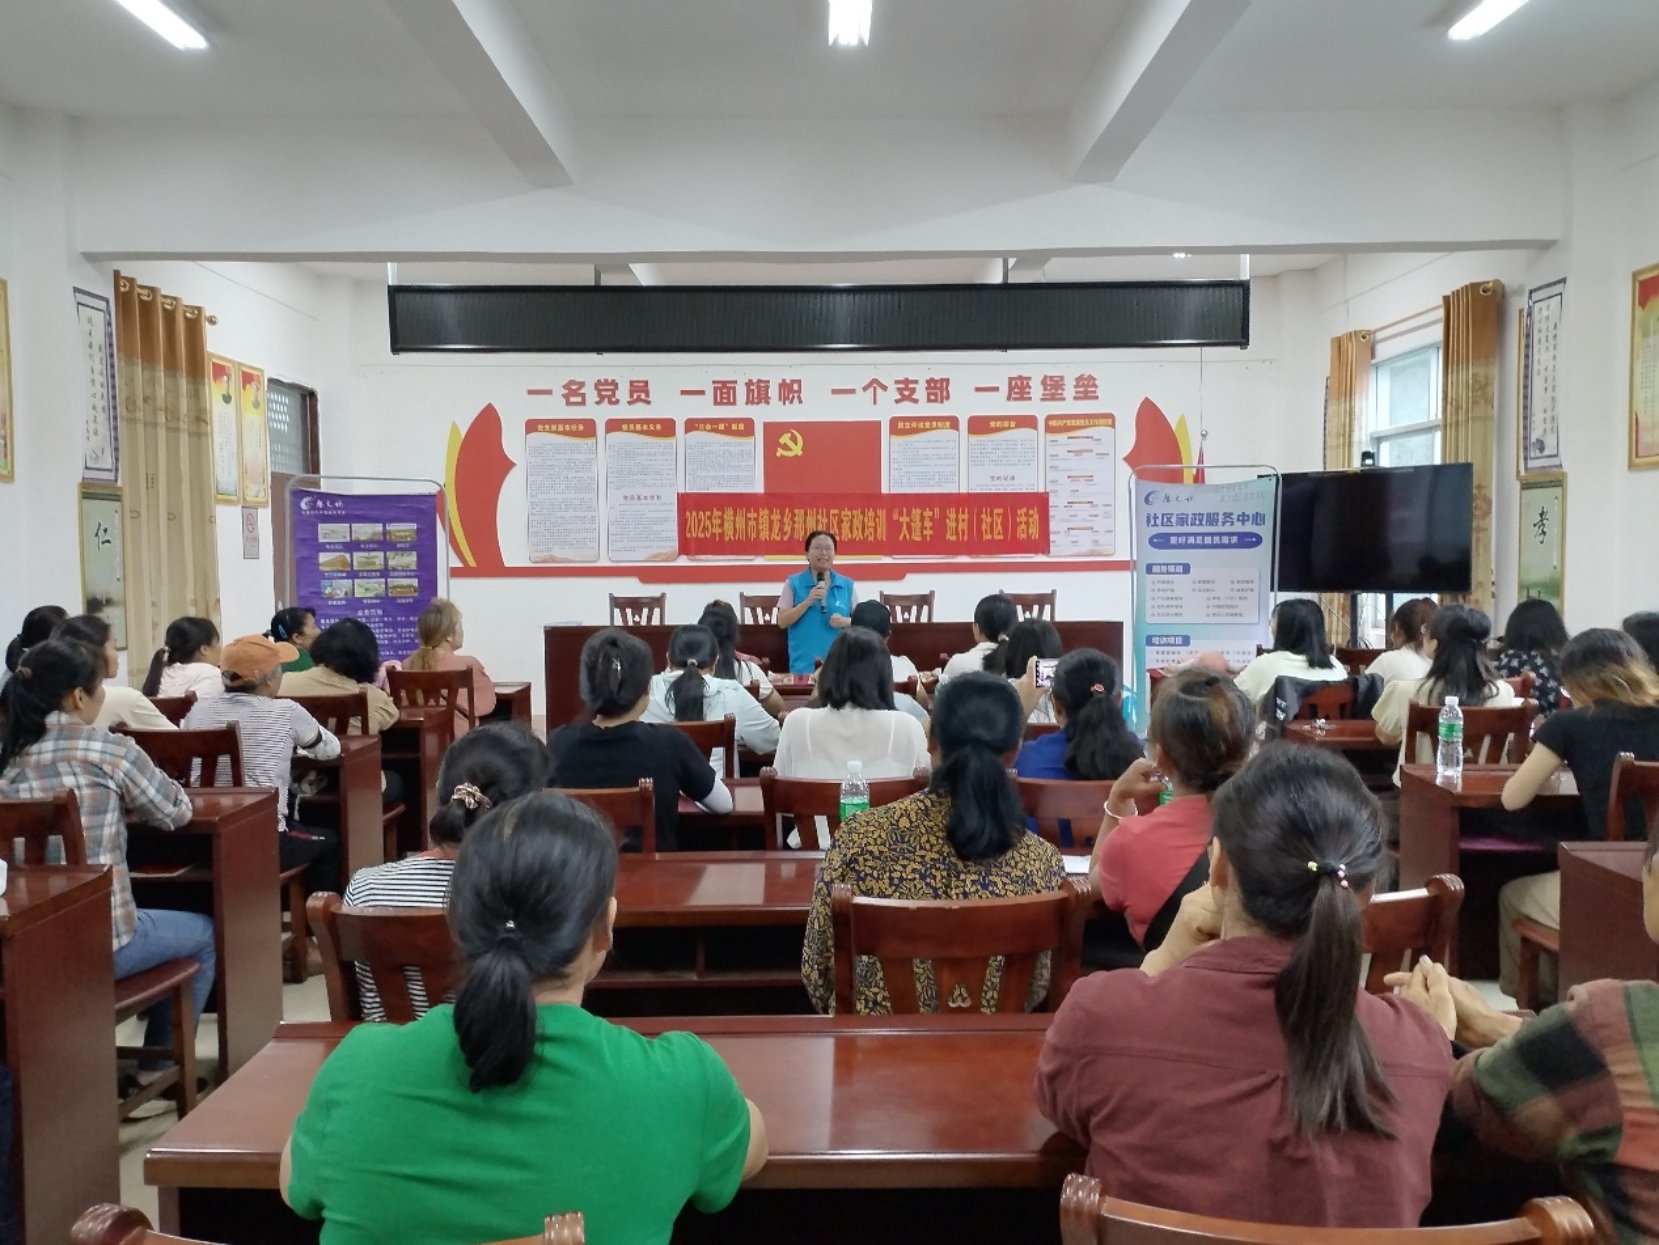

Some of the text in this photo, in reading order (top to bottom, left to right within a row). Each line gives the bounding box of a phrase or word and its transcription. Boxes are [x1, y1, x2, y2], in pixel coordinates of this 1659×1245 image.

[527, 374, 1100, 406] 一名党员 一面旗帜 一个支部 一座堡垒
[1145, 511, 1266, 528] 社区家政服务中心
